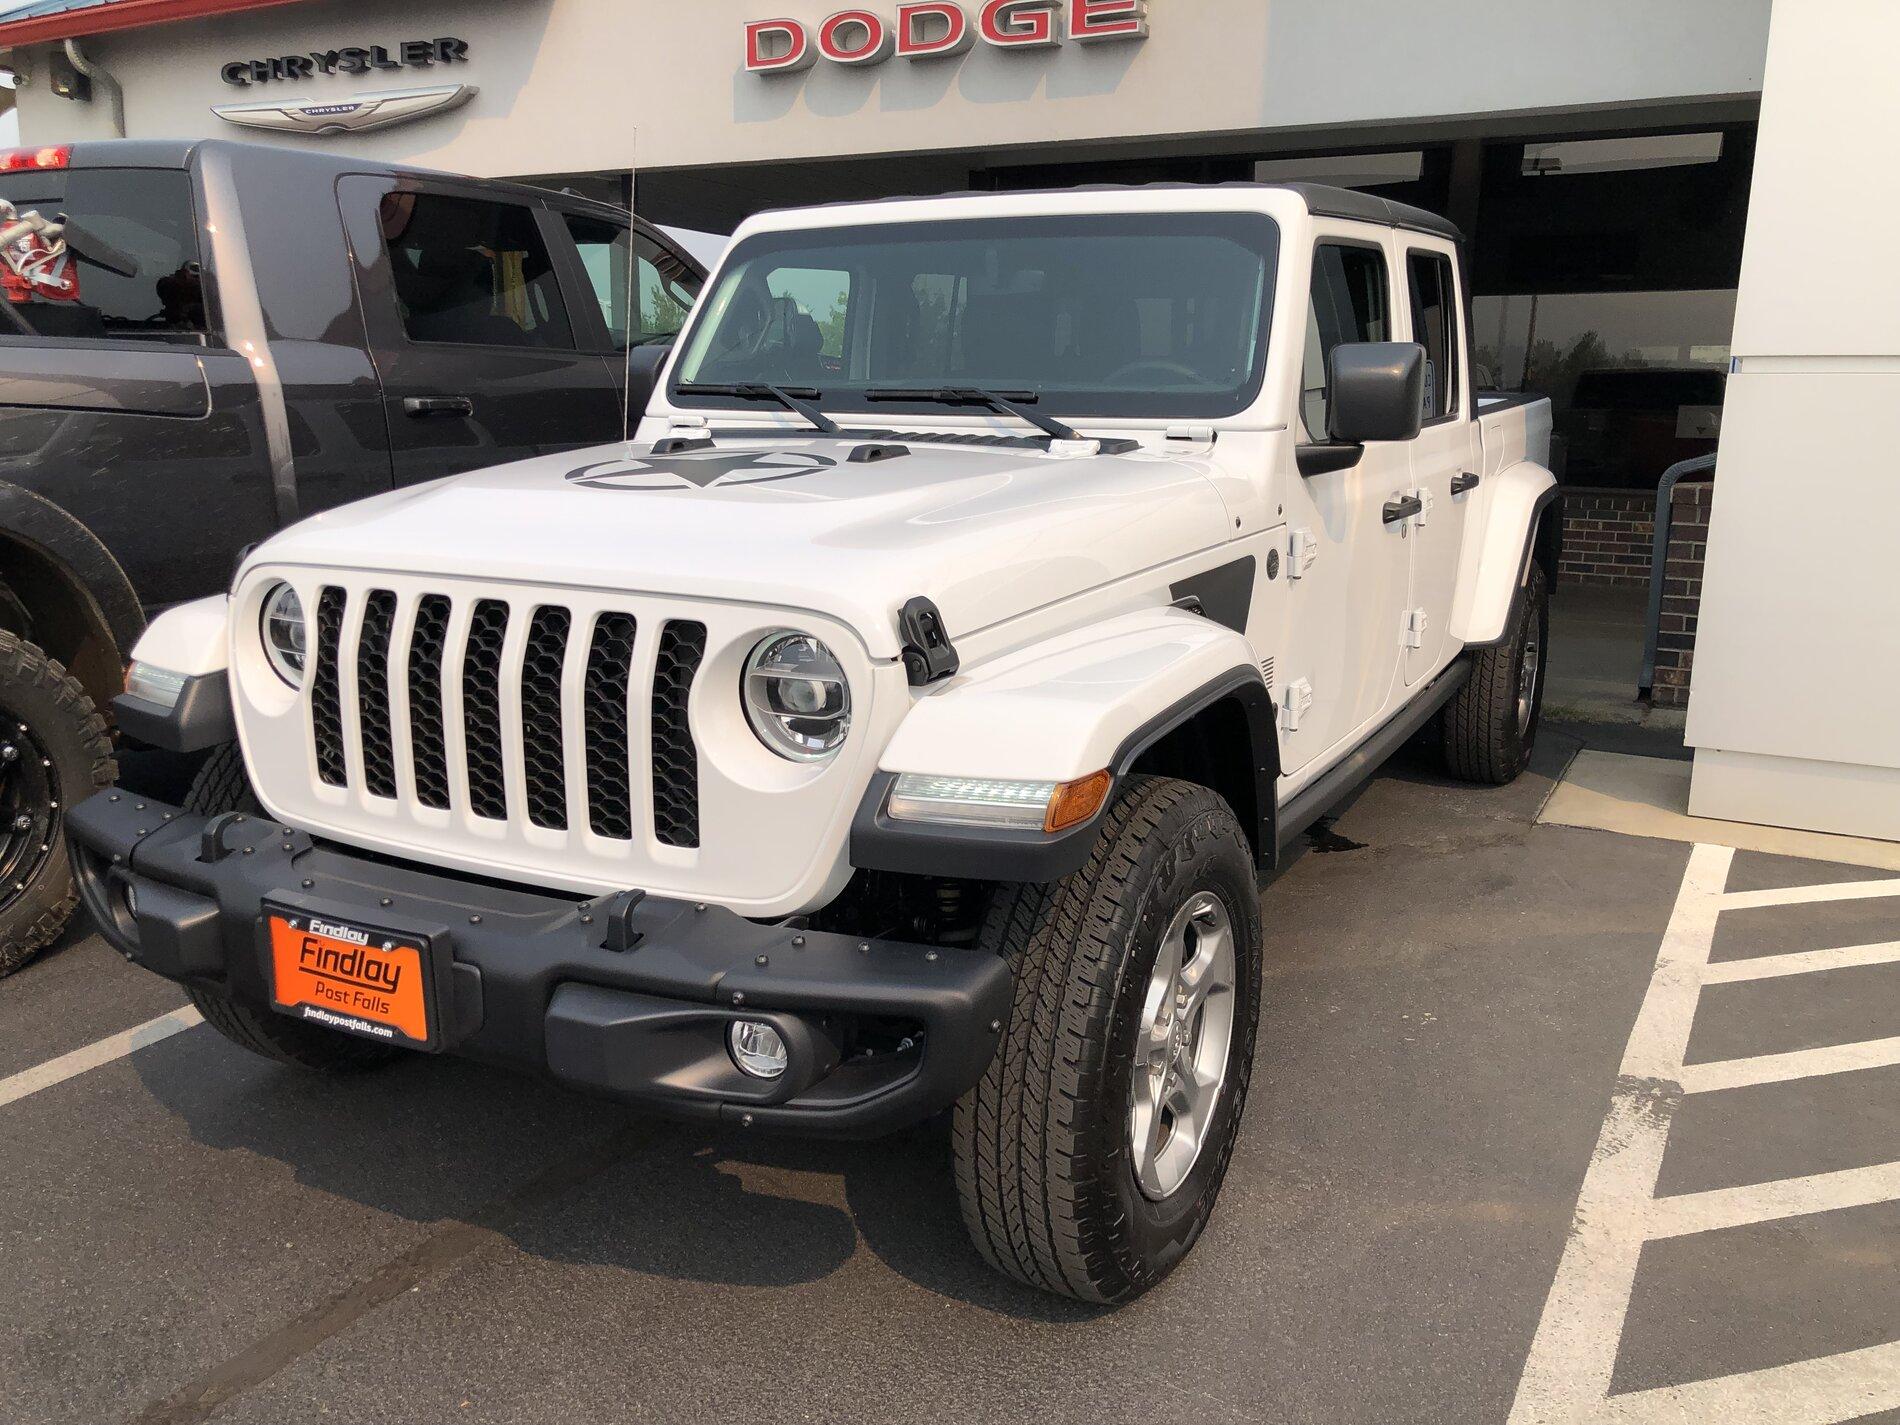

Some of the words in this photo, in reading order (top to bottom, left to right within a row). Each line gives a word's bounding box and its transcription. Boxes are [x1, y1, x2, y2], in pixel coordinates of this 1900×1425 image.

[744, 0, 1149, 74] DODGE
[221, 37, 469, 86] CHRYSLER
[305, 105, 355, 115] CHRYSLER
[308, 919, 369, 946] Findlay
[299, 937, 401, 994] Findlay
[315, 981, 349, 1004] Post
[353, 991, 391, 1015] Falls
[304, 1006, 393, 1037] findlaypostfalls.com
